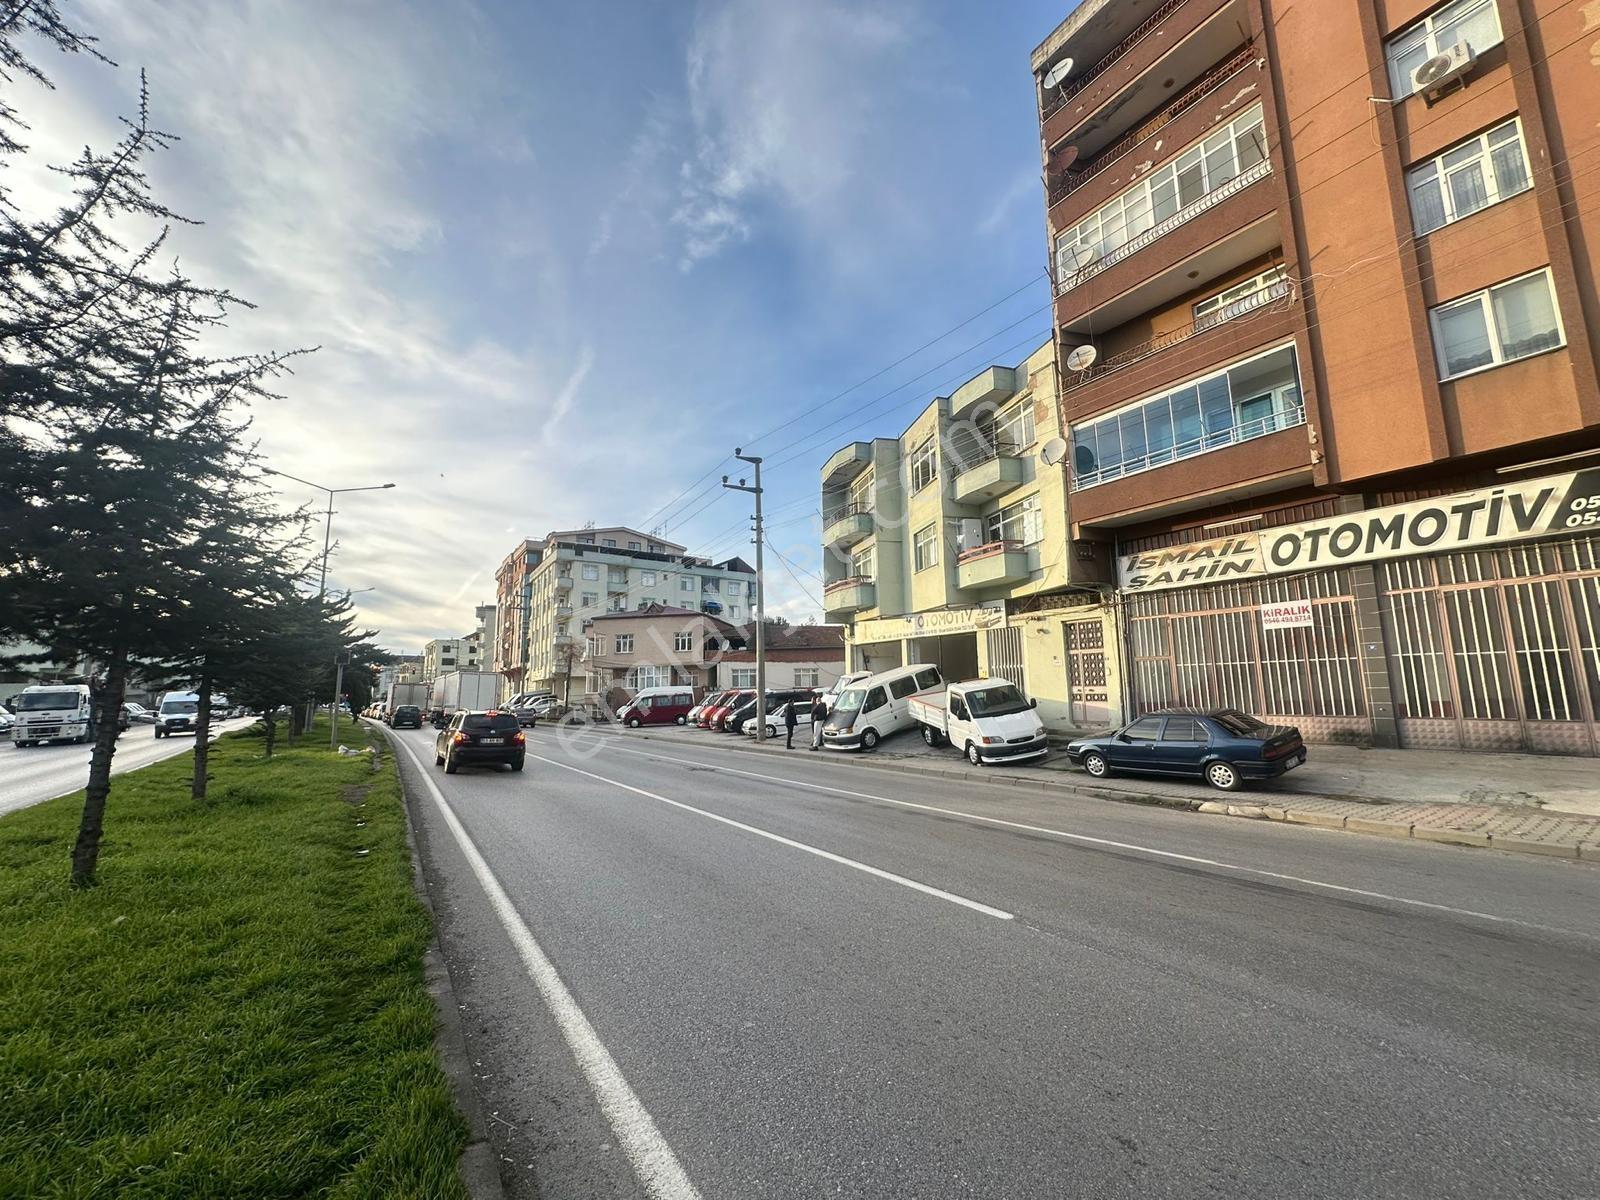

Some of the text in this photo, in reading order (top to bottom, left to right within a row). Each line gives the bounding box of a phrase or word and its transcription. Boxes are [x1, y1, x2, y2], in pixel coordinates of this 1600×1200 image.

[1271, 487, 1555, 567] OTOMOTİV
[1566, 511, 1600, 527] 05
[1126, 538, 1255, 572] İSMAİL
